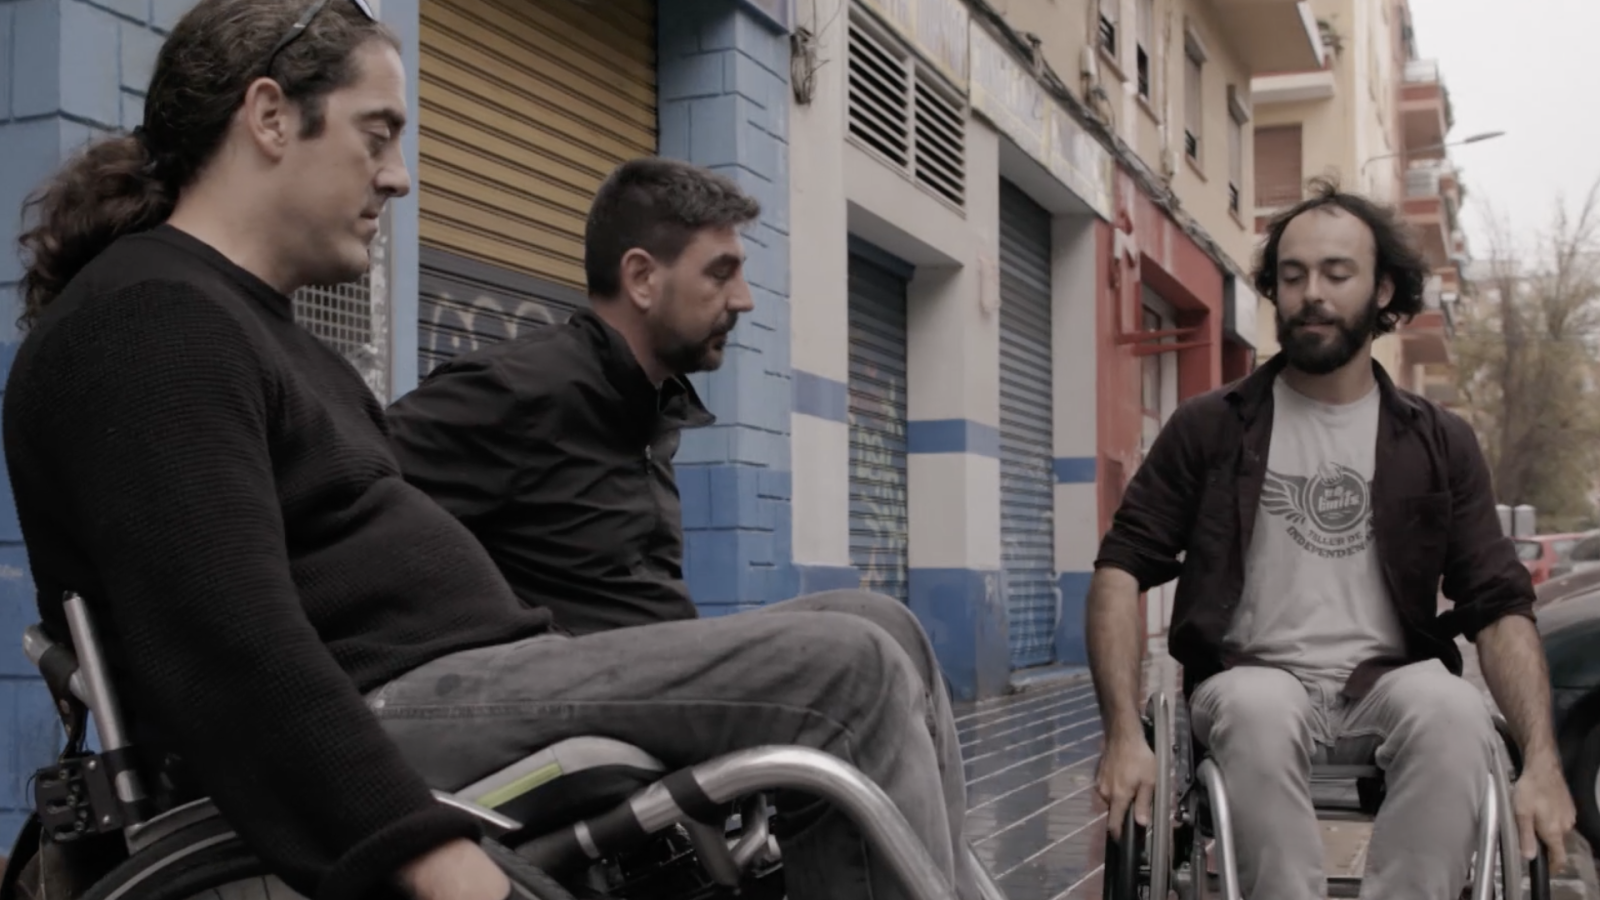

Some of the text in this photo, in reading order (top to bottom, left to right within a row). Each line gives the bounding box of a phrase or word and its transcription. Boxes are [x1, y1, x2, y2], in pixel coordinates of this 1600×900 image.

[1286, 526, 1373, 558] INDEPENDEN
[1308, 530, 1363, 546] TALLER DE
